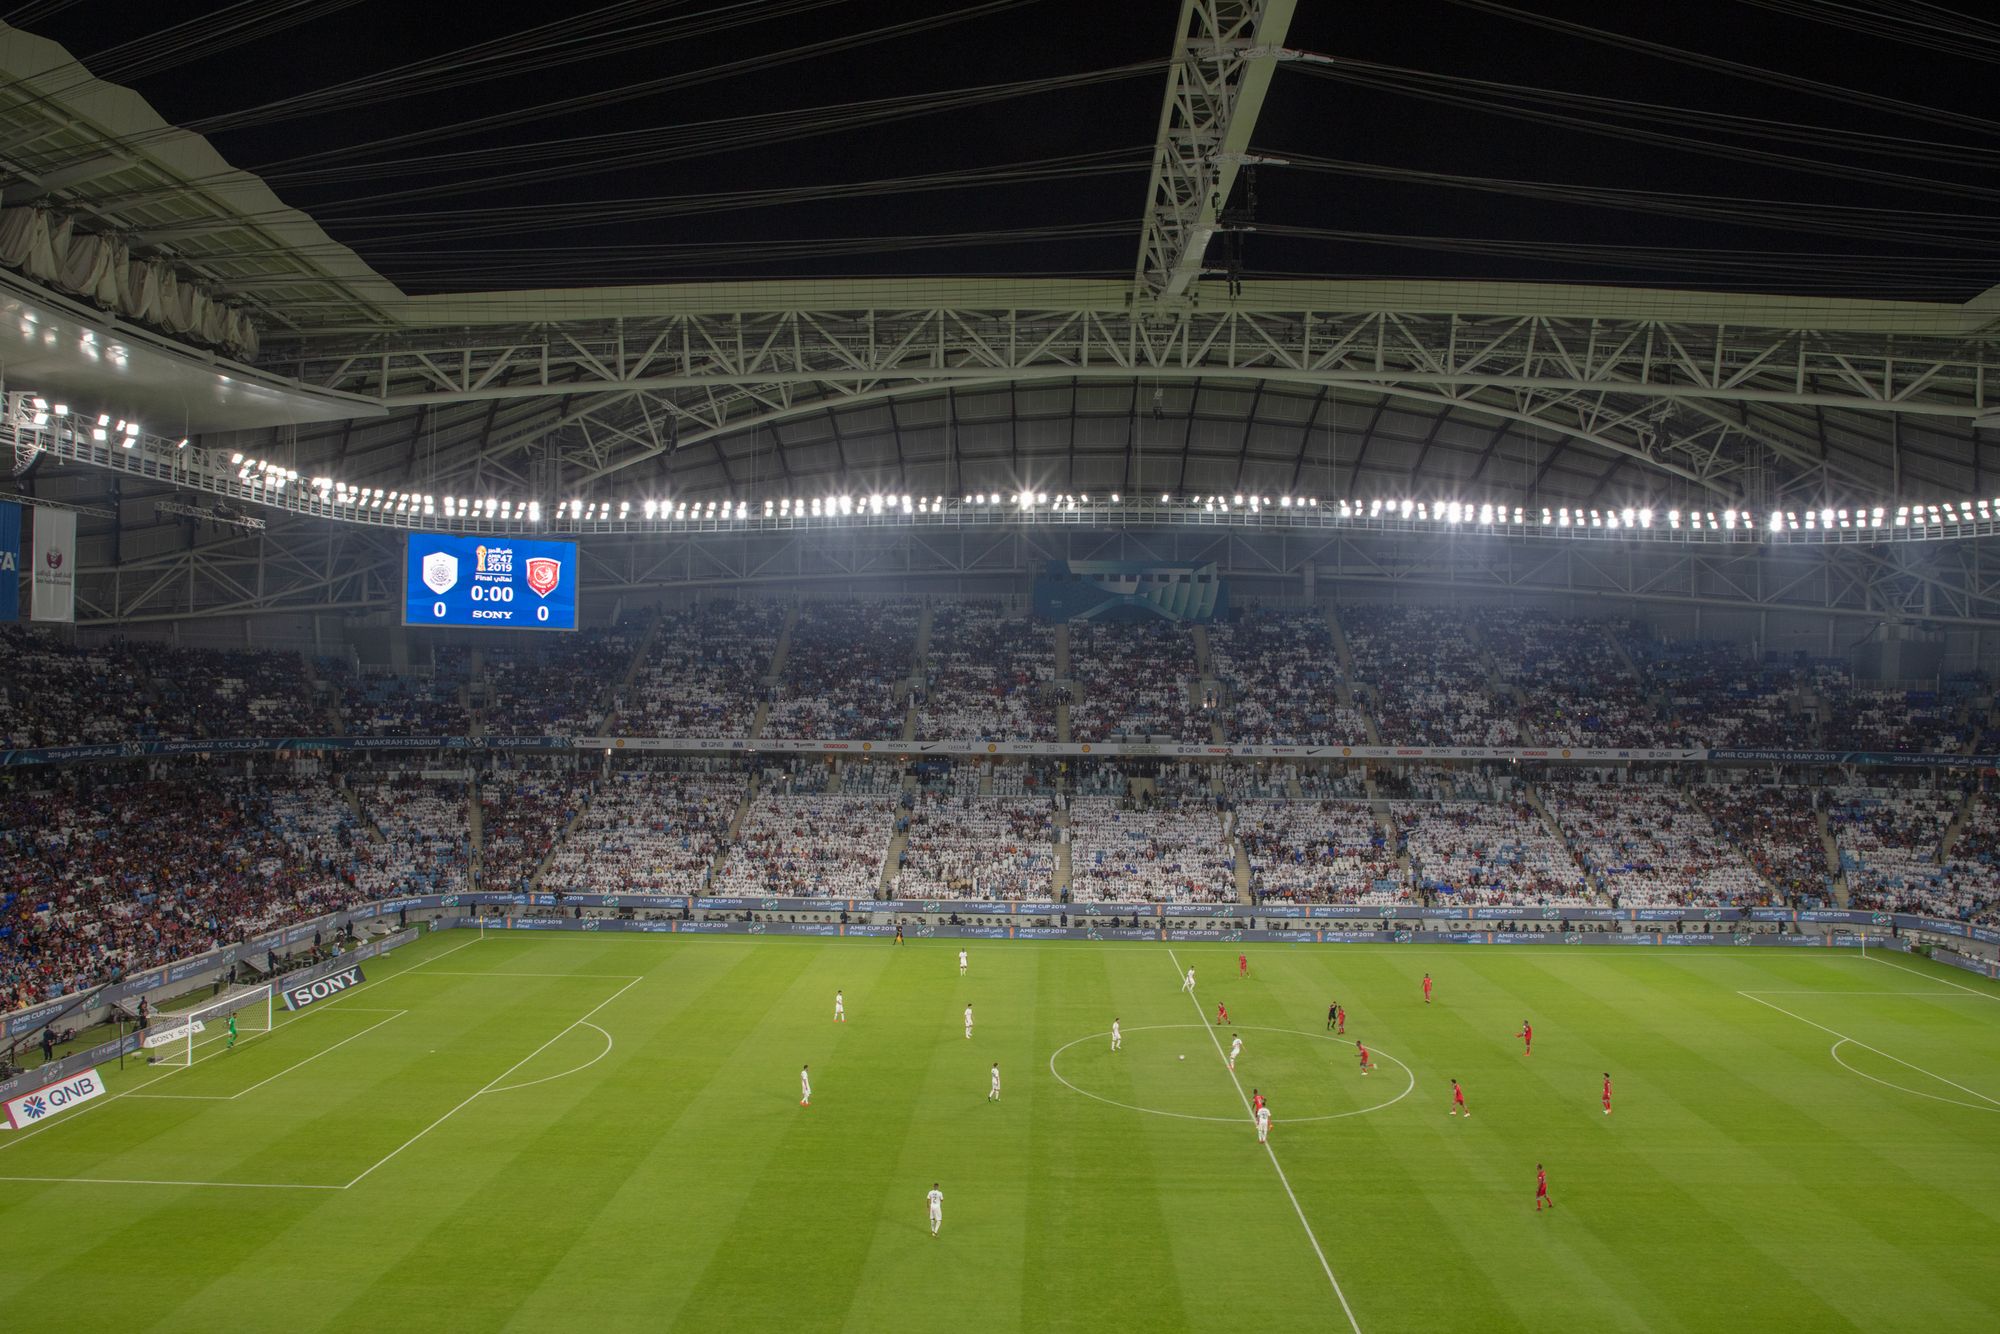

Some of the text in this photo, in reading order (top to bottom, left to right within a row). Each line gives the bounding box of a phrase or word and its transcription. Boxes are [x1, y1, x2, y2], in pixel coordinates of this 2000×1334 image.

[488, 563, 512, 572] 2019
[471, 586, 513, 602] 0:00
[434, 602, 446, 617] 0
[472, 611, 513, 619] SONY
[537, 606, 549, 621] 0
[295, 968, 358, 1006] SONY
[12, 1004, 63, 1025] AMIR CUP 2019
[151, 1032, 174, 1044] SONY
[49, 1078, 94, 1106] QNB
